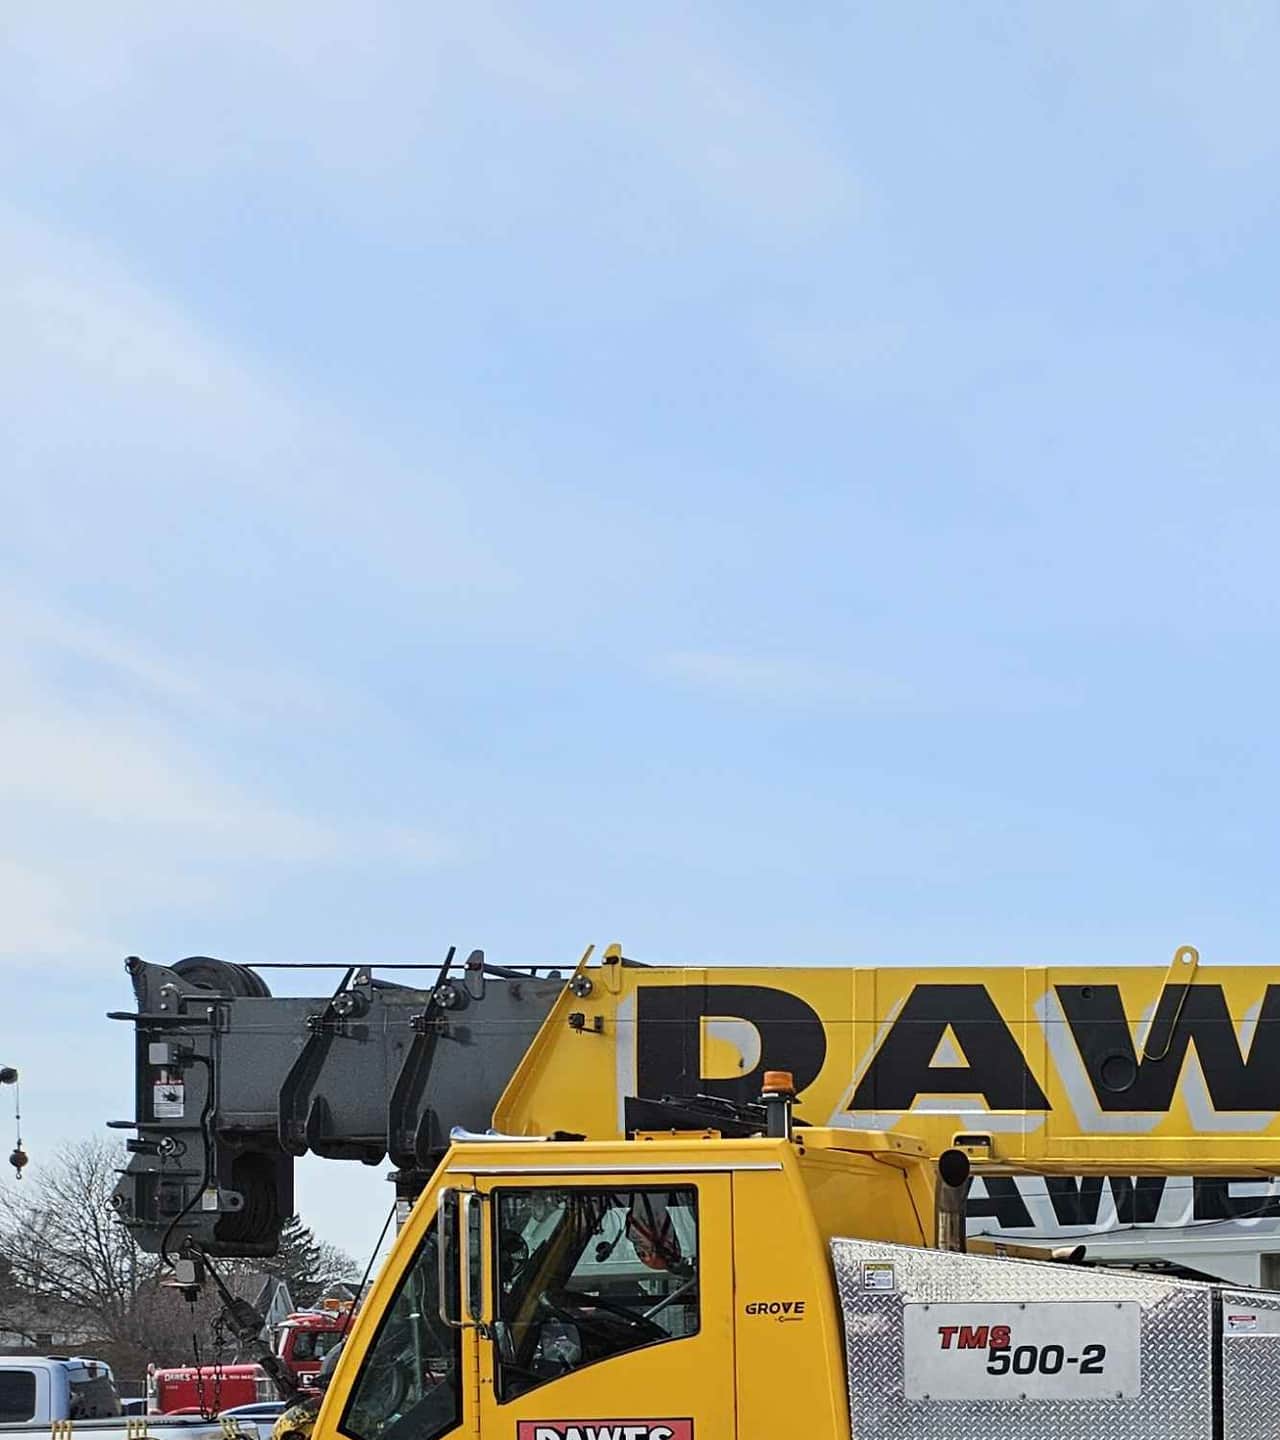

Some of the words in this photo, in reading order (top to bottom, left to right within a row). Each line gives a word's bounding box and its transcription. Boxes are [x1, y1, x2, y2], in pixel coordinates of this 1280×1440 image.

[745, 1302, 805, 1314] GROVE
[938, 1325, 1011, 1350] TMS
[986, 1344, 1106, 1375] 500-2
